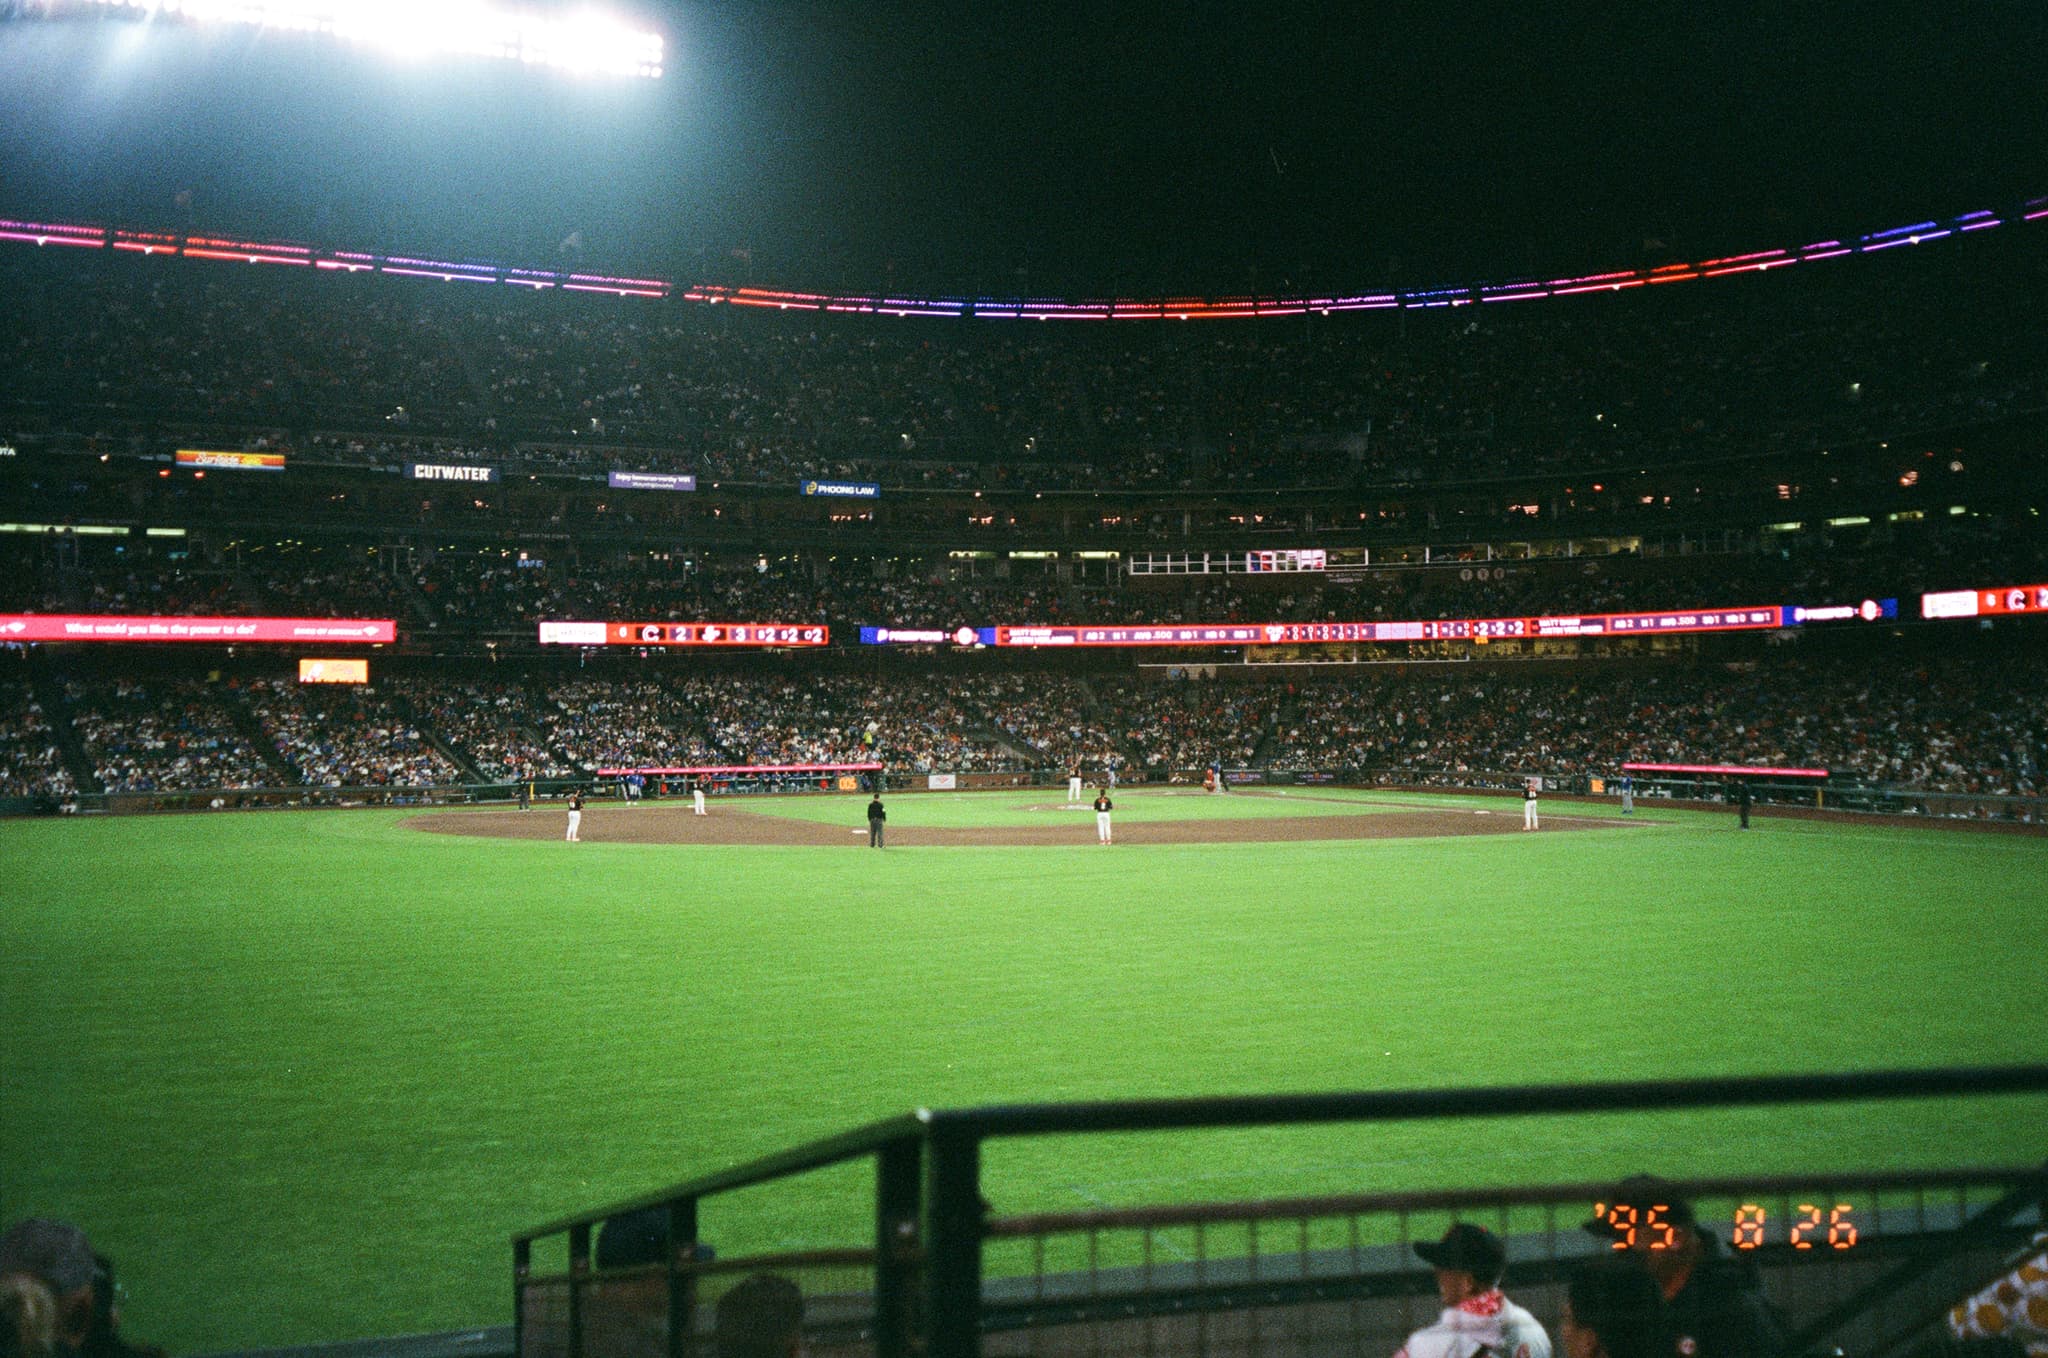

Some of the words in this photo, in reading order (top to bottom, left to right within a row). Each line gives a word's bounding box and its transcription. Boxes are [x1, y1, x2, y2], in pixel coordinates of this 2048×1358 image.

[414, 464, 490, 481] CUTWATER
[855, 487, 875, 495] LAW
[2007, 590, 2025, 610] C
[65, 623, 93, 633] What
[95, 623, 127, 633] would
[127, 625, 148, 636] you
[149, 624, 169, 634] like
[170, 624, 188, 634] the
[189, 625, 221, 637] power
[223, 625, 235, 634] to
[236, 624, 257, 634] do?
[675, 627, 686, 641] 2
[735, 627, 746, 641] 3
